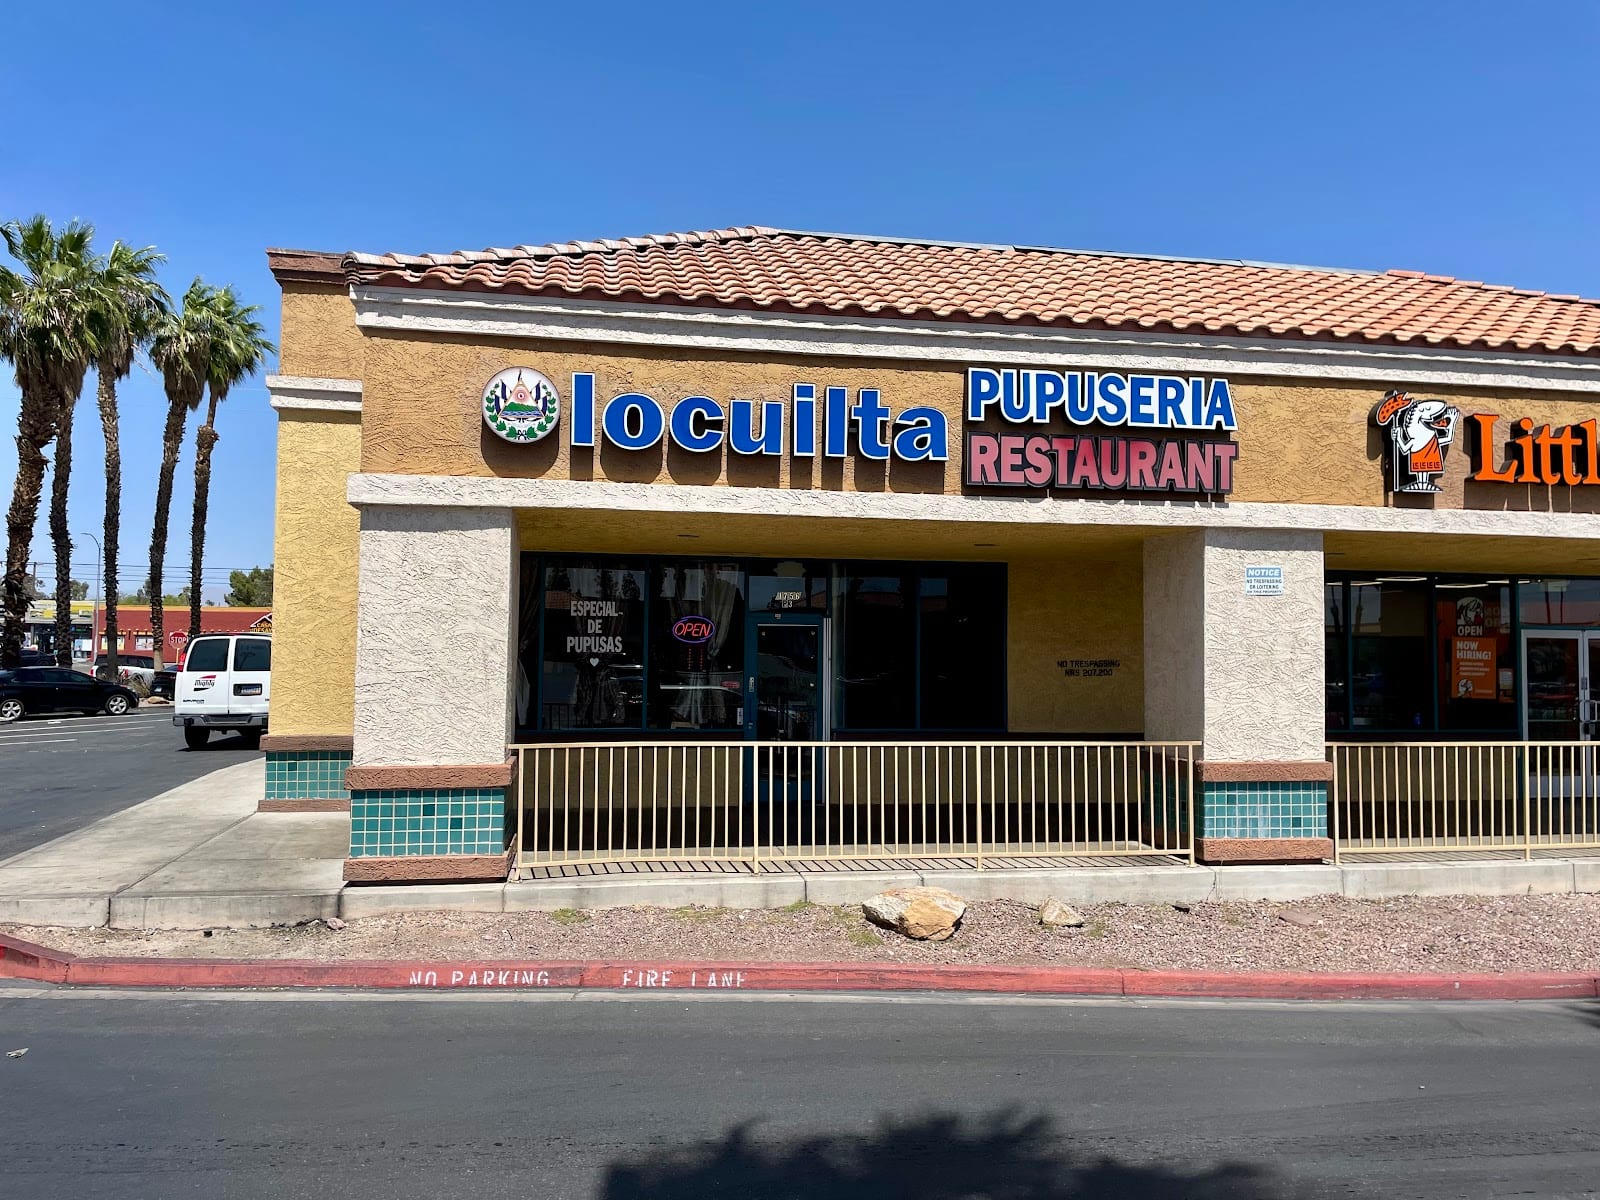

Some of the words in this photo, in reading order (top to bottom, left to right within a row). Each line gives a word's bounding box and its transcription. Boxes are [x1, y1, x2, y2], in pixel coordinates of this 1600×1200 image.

[968, 367, 1238, 431] PUPUSERIA
[968, 433, 1238, 493] RESTAURANT
[1247, 568, 1281, 577] NOTICE
[570, 600, 618, 617] ESPECIAL
[587, 619, 603, 634] DE
[674, 622, 712, 637] OPEN
[1457, 625, 1483, 637] OPEN
[566, 635, 623, 653] PUPUSAS
[1456, 641, 1479, 651] NOW
[1456, 650, 1492, 660] HIRING!
[1057, 660, 1068, 668] NO
[1070, 660, 1120, 668] TRESPASSING
[409, 971, 437, 986] NO
[451, 970, 549, 986] PARKING
[623, 969, 674, 987] FIRE
